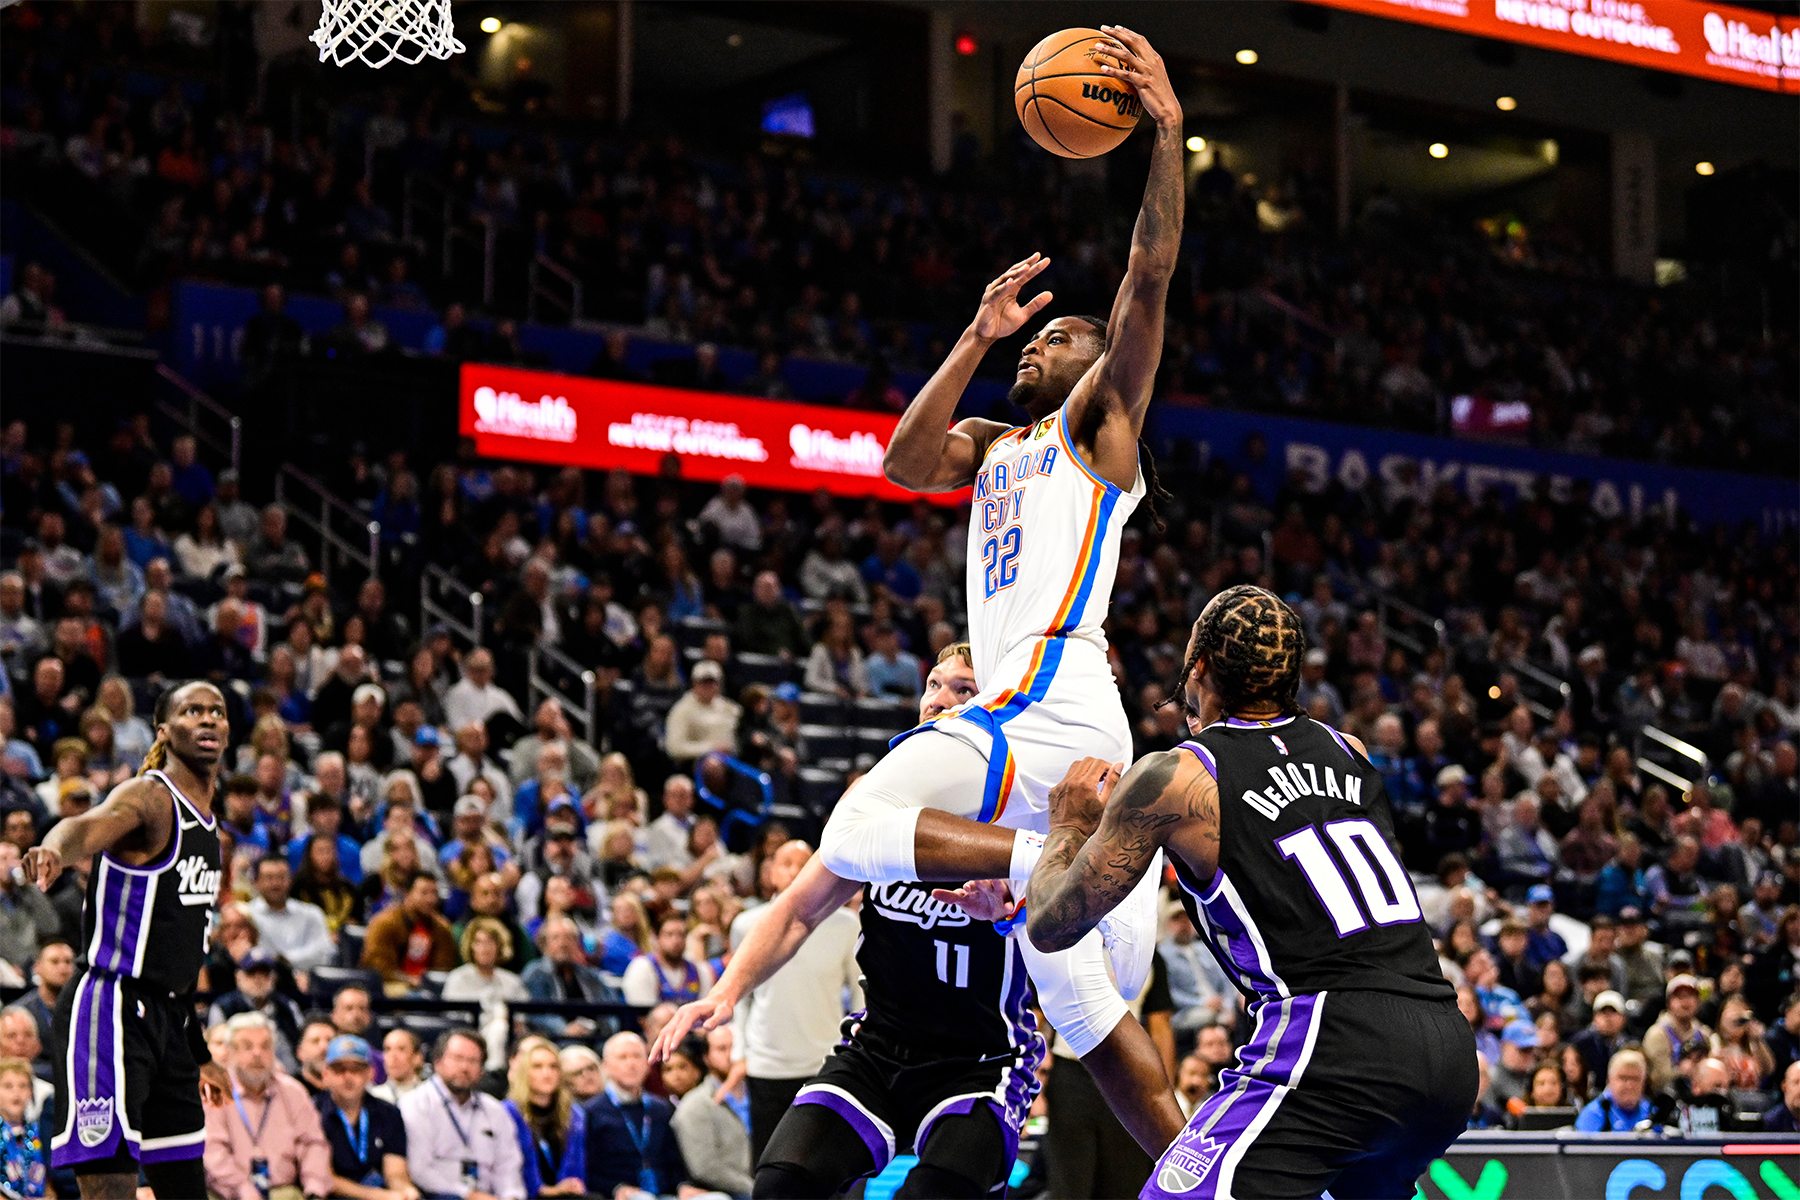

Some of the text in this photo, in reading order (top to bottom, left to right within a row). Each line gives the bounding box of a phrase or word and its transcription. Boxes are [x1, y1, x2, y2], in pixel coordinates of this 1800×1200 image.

[1495, 0, 1570, 33] NEVER
[982, 524, 1023, 604] 22
[176, 855, 222, 907] King
[1273, 817, 1423, 939] 10
[933, 939, 970, 989] 11
[1166, 1150, 1208, 1179] KINGS
